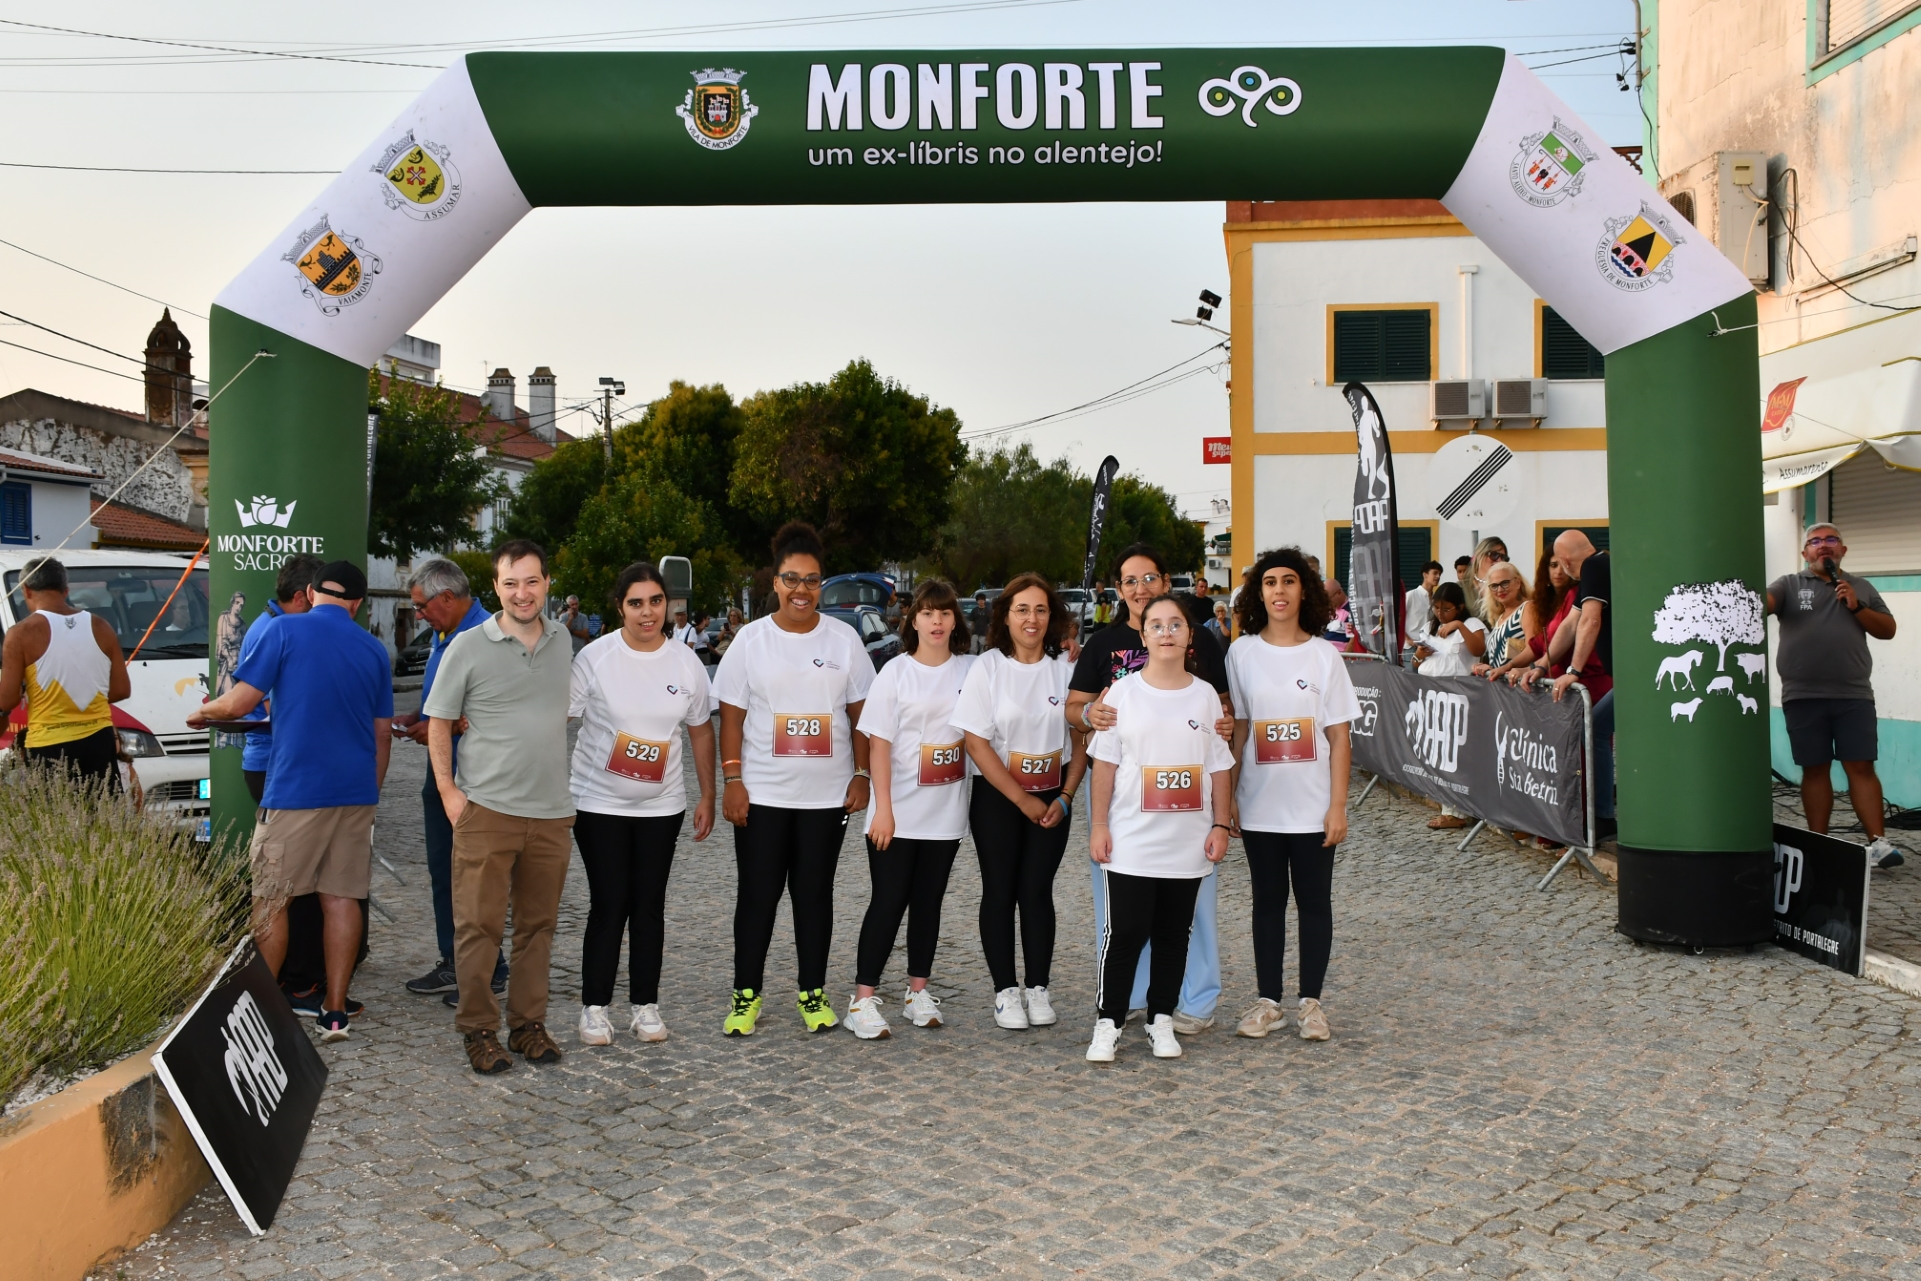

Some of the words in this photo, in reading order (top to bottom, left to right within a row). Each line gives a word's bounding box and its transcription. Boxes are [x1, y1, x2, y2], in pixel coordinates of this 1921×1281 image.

[806, 62, 1164, 131] MONFORTE
[688, 125, 701, 141] VILA
[700, 137, 711, 148] DE
[711, 124, 748, 149] MONFORTE
[808, 147, 854, 166] um
[863, 140, 979, 166] ex-líbris
[988, 147, 1025, 165] no
[1034, 140, 1163, 168] alentejo!
[423, 183, 460, 220] ASSUMAR
[1528, 195, 1556, 207] MONFORTE
[1597, 237, 1611, 274] FREGUESIA
[1606, 272, 1616, 282] DE
[1615, 277, 1654, 290] MONFORTE
[337, 272, 372, 305] VAIAMONTE
[217, 534, 324, 554] MONFORTE
[786, 717, 822, 737] 528
[1266, 722, 1303, 743] 525
[625, 740, 661, 763] 529
[932, 745, 961, 766] 530
[1510, 727, 1558, 774] Clínica
[1021, 756, 1053, 775] 527
[1156, 770, 1192, 790] 526
[1508, 766, 1523, 792] Sta
[1524, 771, 1559, 806] Betriz
[1793, 926, 1802, 941] DE
[1802, 929, 1840, 956] PORTALEGRE
